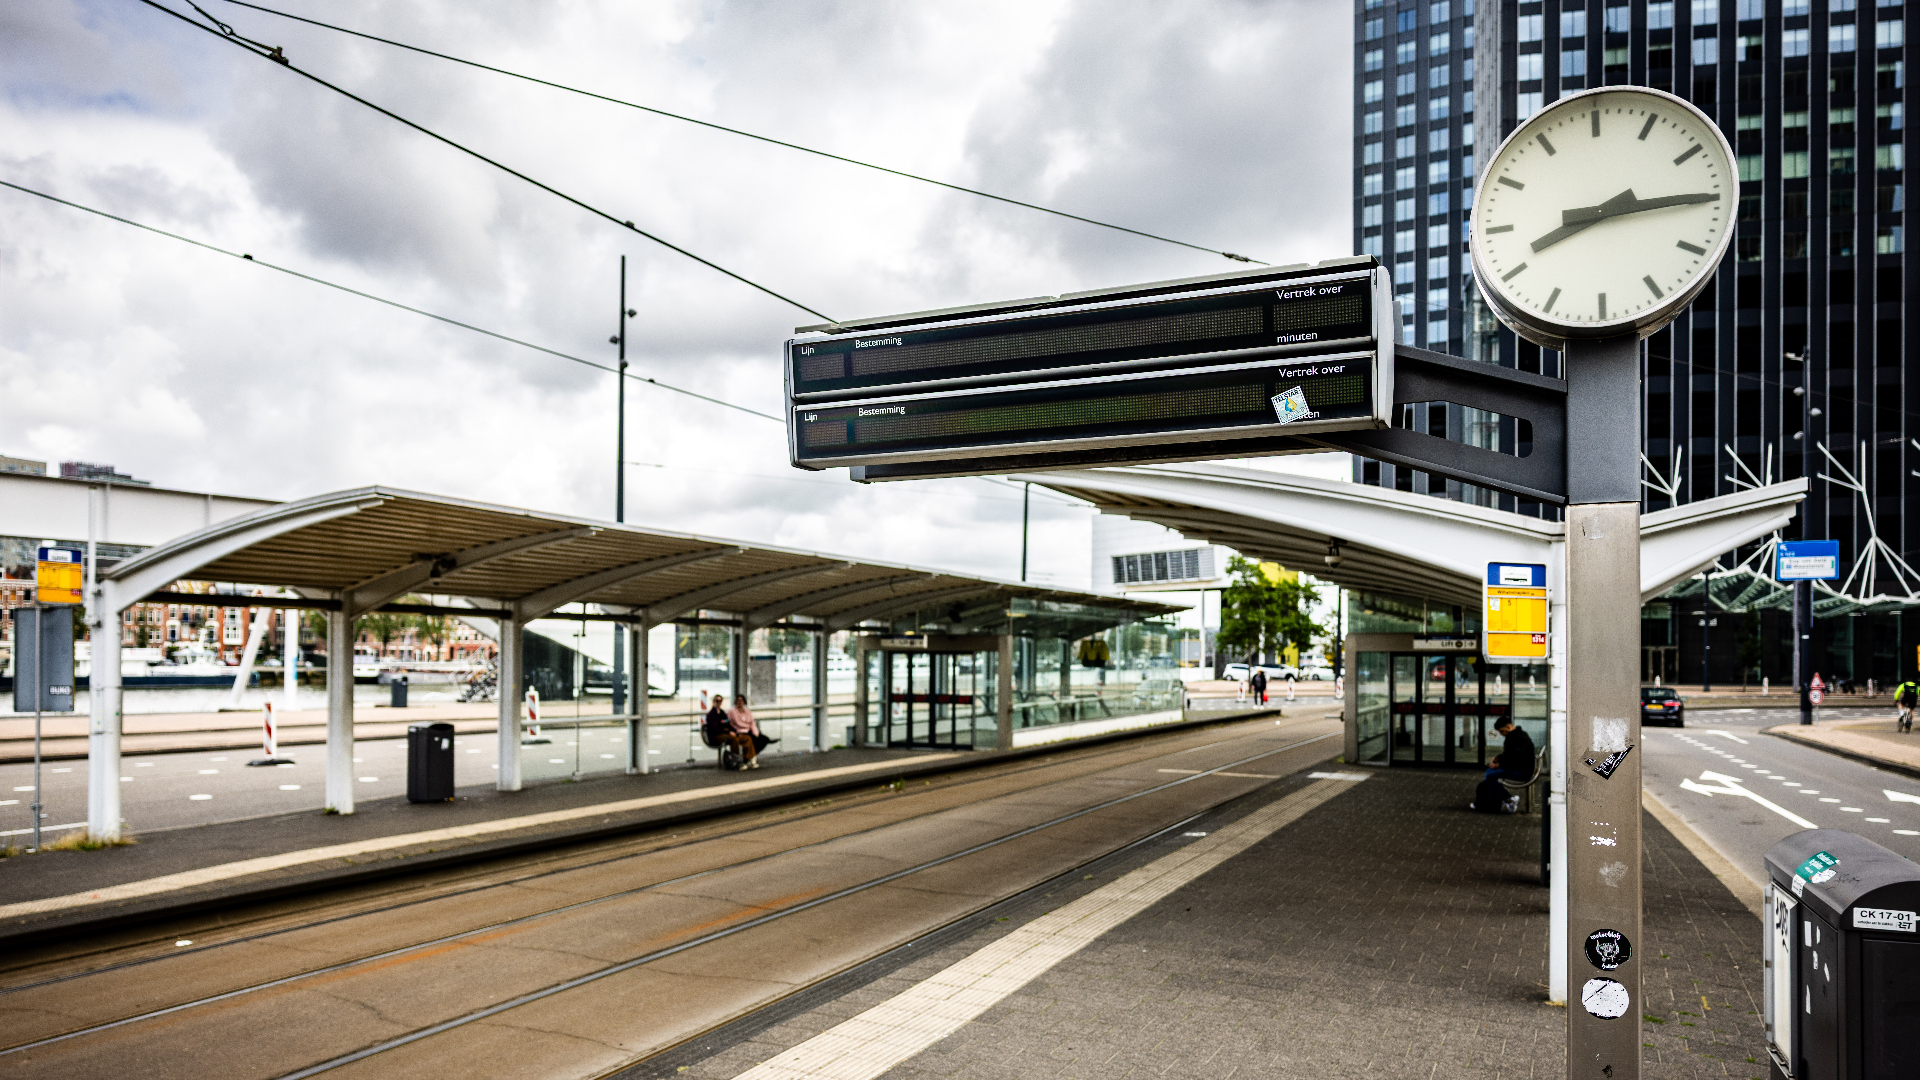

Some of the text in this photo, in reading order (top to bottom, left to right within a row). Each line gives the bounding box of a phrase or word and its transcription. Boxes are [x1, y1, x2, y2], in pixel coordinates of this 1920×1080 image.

[1276, 286, 1343, 299] Vertrek over
[855, 337, 902, 348] Bestemming
[1277, 332, 1318, 343] minuten
[801, 346, 815, 356] Lijn
[1279, 365, 1345, 378] Vertrek over
[858, 405, 905, 416] Bestemming
[804, 412, 817, 422] Lijn
[1860, 910, 1910, 921] CK 17-01
